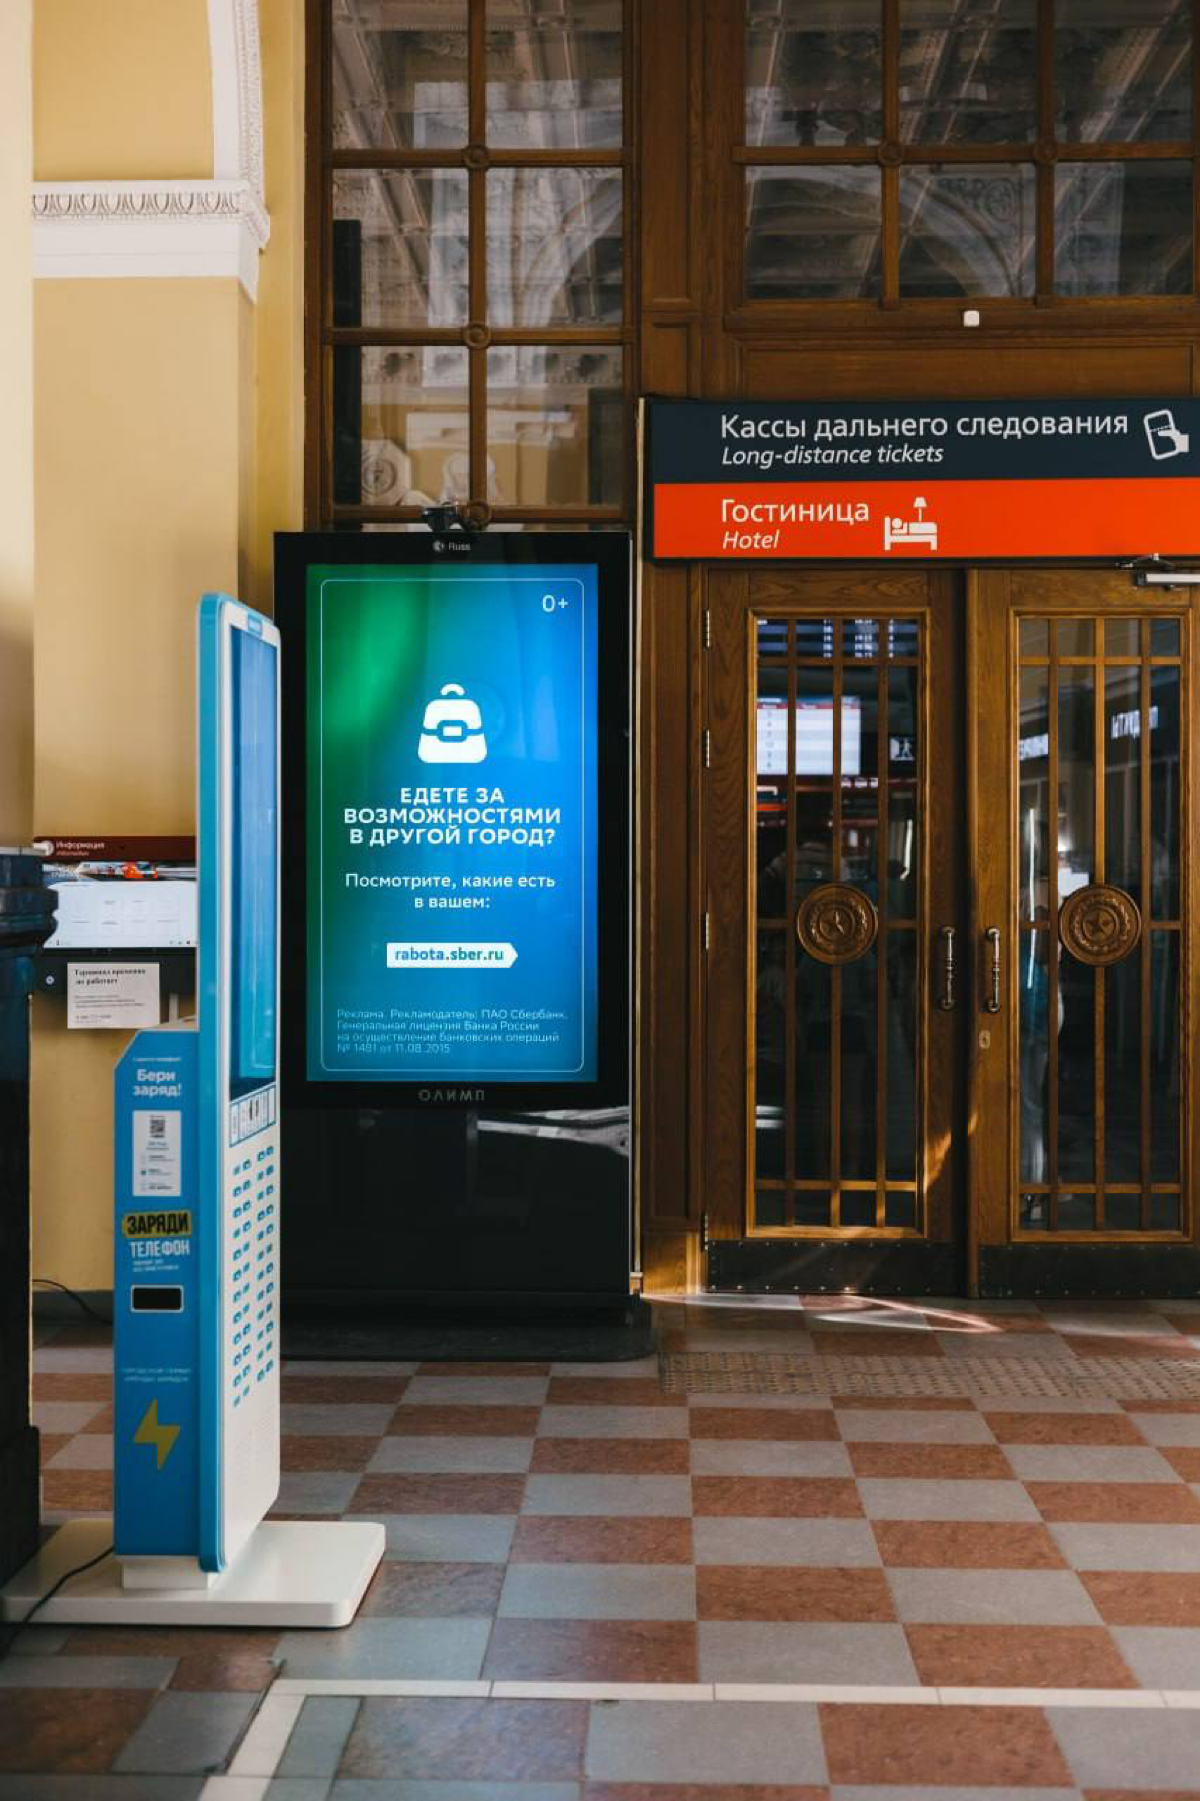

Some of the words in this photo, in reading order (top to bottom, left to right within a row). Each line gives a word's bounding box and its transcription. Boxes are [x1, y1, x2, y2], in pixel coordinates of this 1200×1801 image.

[720, 414, 807, 440] Кассы
[814, 415, 948, 442] дальнего
[957, 412, 1129, 439] следования
[721, 445, 872, 469] Long-distance
[878, 444, 945, 465] tickets
[720, 498, 870, 526] Гостиница
[722, 530, 780, 551] Hotel
[541, 594, 569, 613] 0+
[400, 787, 469, 806] ЕДЕТЕ
[475, 787, 505, 804] ЗА
[344, 808, 562, 825] ВОЗМОЖНОСТЯМИ
[349, 828, 364, 845] В
[369, 824, 462, 847] ДРУГОЙ
[467, 828, 556, 847] ГОРОД?
[345, 872, 457, 890] Посмотрите,
[462, 876, 513, 888] какие
[518, 876, 556, 888] есть
[414, 897, 424, 909] в
[428, 896, 491, 909] вашем:
[394, 945, 505, 962] rabota.sber.ru
[481, 1008, 507, 1019] ПАО
[337, 1021, 406, 1032] Генеральная
[409, 1022, 461, 1032] лицензия
[463, 1021, 498, 1031] Банка
[500, 1021, 540, 1031] России
[352, 1033, 437, 1043] осуществление
[439, 1032, 503, 1042] банковских
[505, 1031, 560, 1043] операций
[136, 1068, 177, 1083] Бери
[132, 1084, 182, 1098] заряд!
[418, 1089, 486, 1102] ОЛИМП
[126, 1212, 189, 1236] ЗАРЯДИ
[129, 1240, 191, 1258] ТЕЛЕФОН
